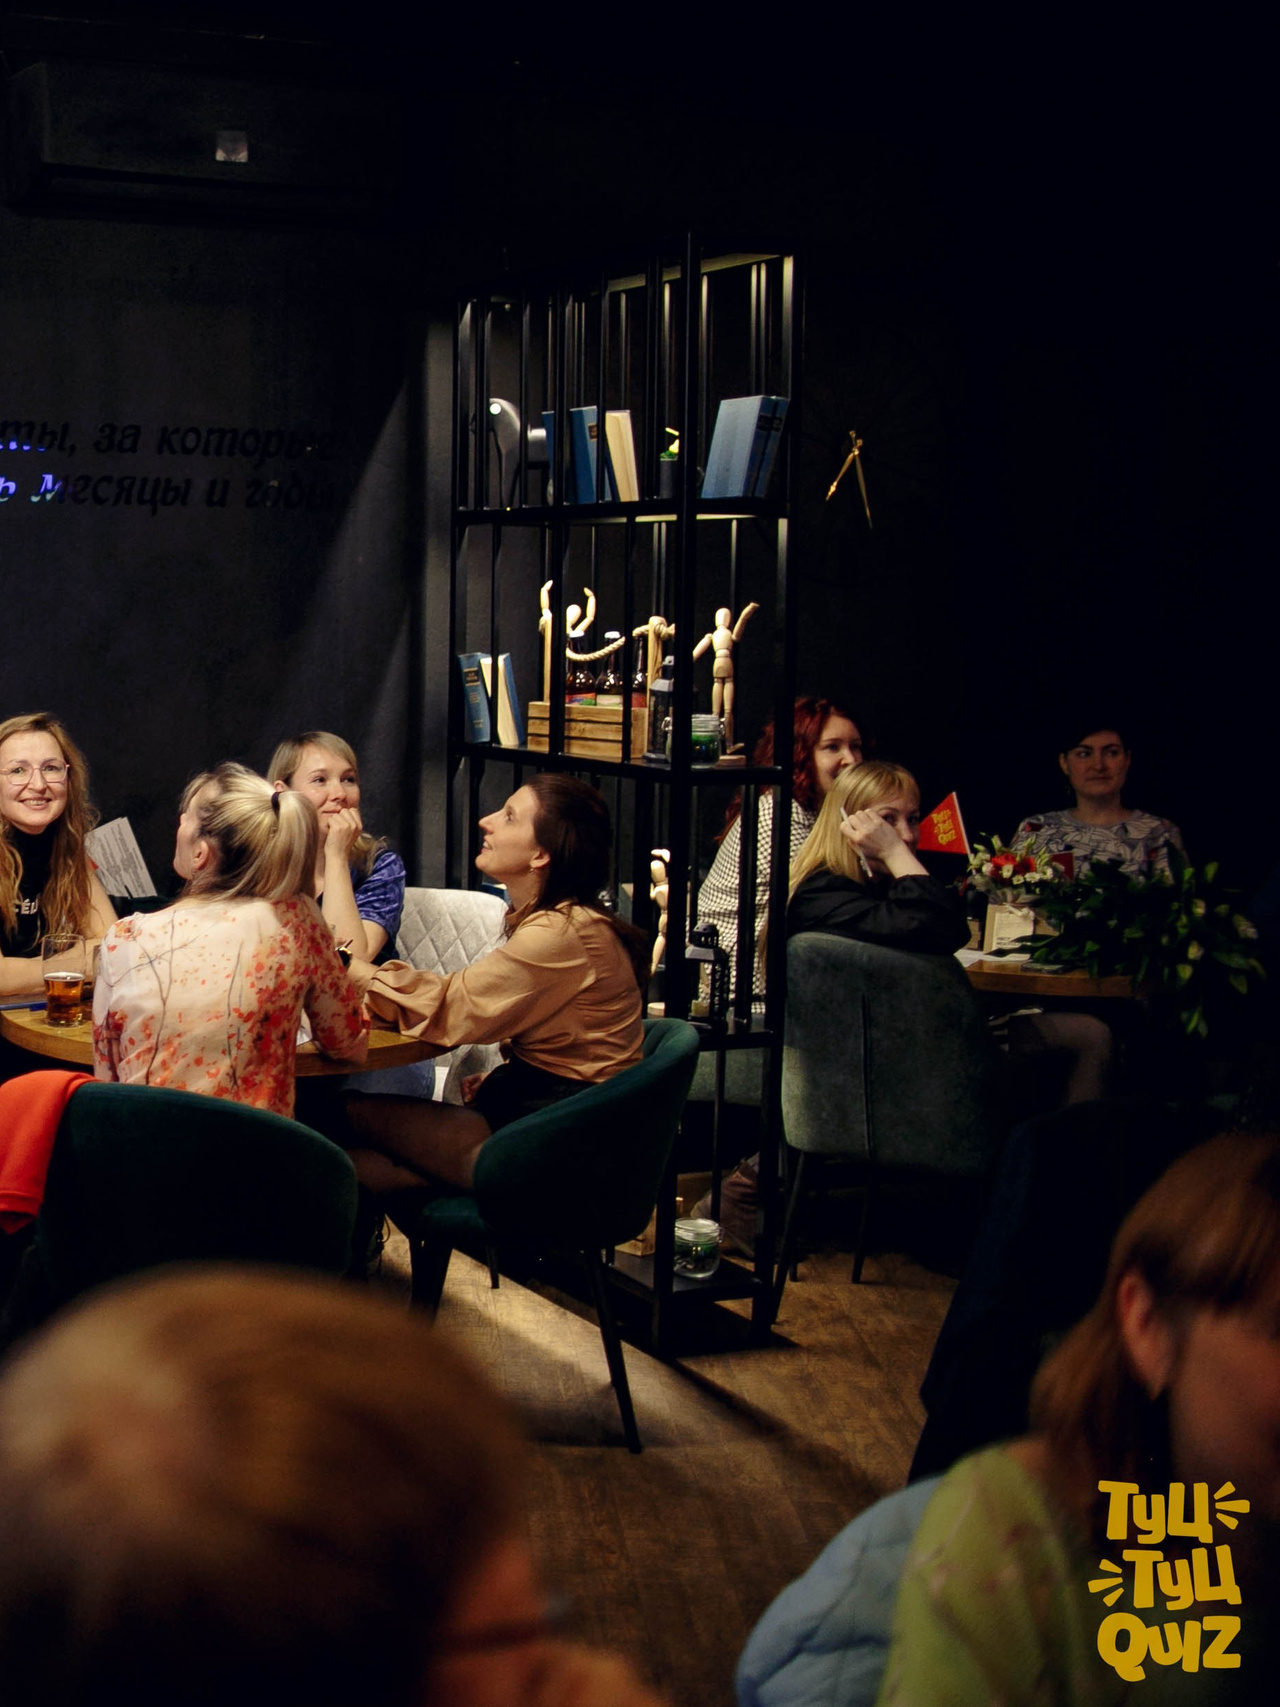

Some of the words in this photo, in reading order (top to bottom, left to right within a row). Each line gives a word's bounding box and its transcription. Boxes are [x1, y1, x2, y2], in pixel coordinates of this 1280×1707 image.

[92, 421, 142, 455] за
[29, 470, 192, 517] месяцы
[204, 477, 231, 508] и
